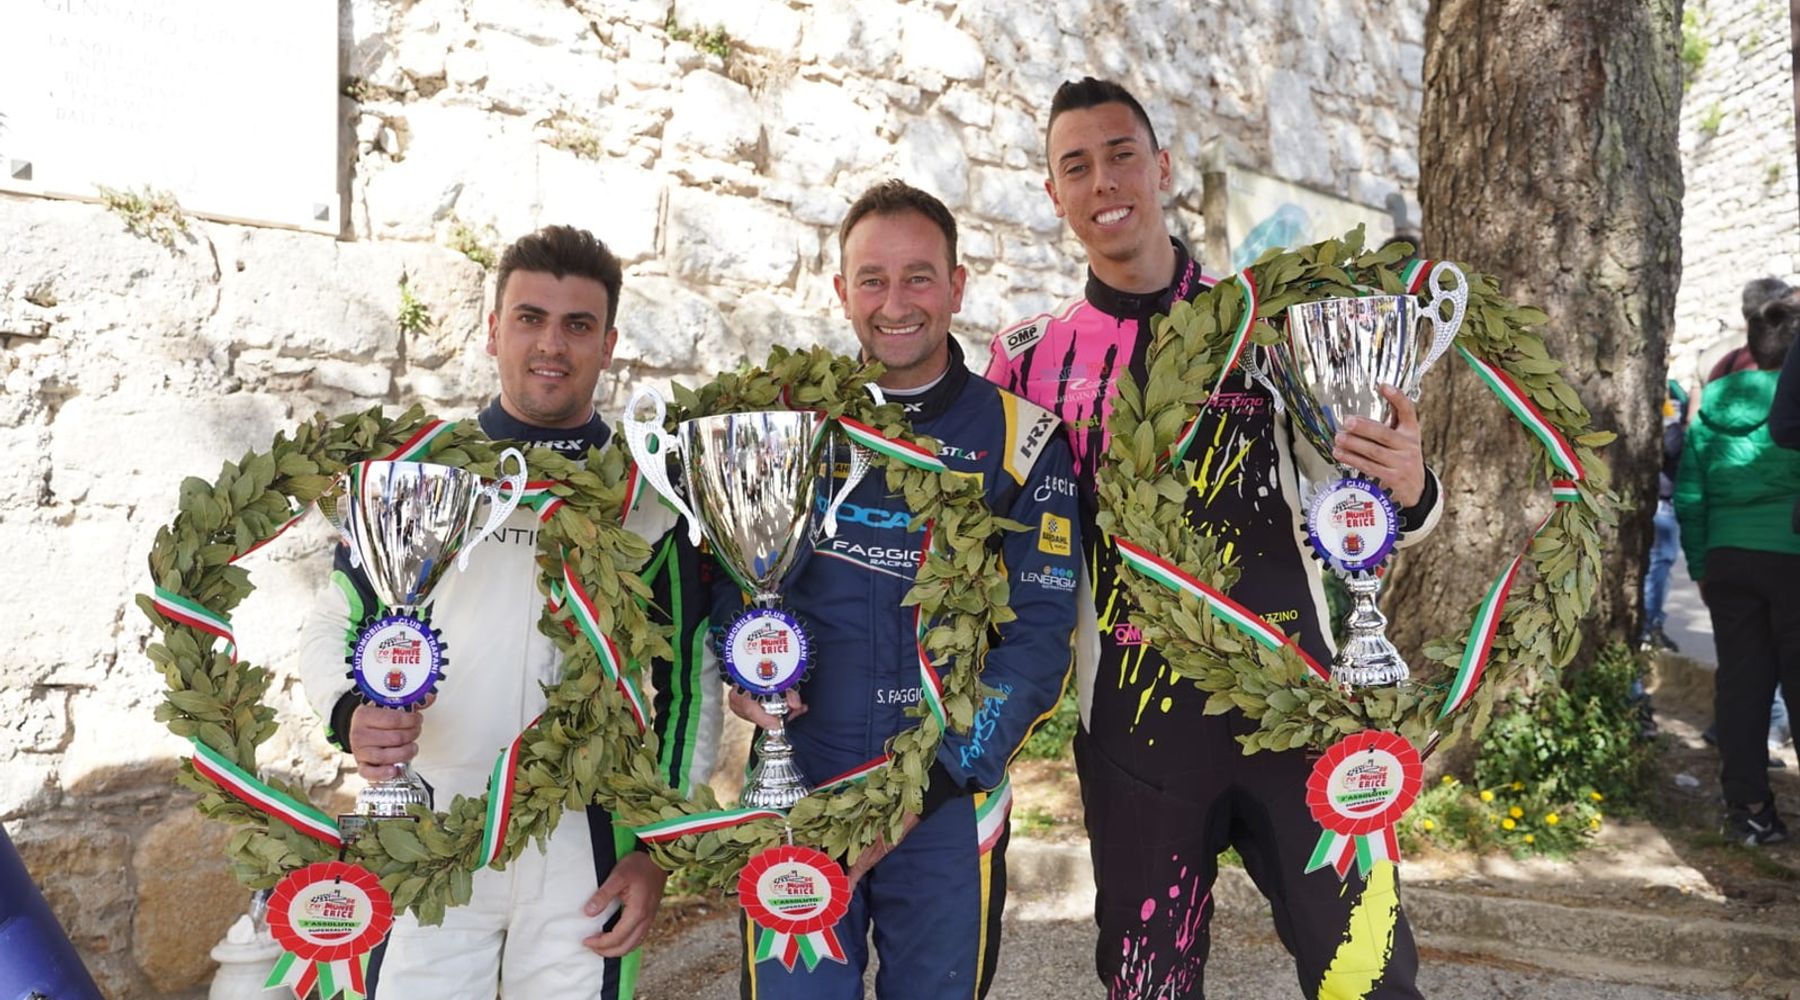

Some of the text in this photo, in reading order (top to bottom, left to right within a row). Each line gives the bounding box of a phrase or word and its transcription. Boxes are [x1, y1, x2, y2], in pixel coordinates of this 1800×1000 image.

[1008, 326, 1038, 346] OMP
[1020, 412, 1053, 459] HRX
[1346, 480, 1371, 491] CLUB
[1378, 495, 1396, 535] TRAPANI
[1346, 518, 1375, 528] ERICE
[870, 558, 913, 569] RACING
[725, 610, 807, 663] AUTOMOBILE CLUB TRAPANI
[354, 617, 439, 674] AUTOMOBILE CLUB TRAPANI
[761, 645, 789, 654] ERICE
[392, 656, 420, 664] ERICE
[876, 689, 886, 704] S.
[1359, 780, 1387, 788] ERICE
[323, 909, 353, 919] ERICE
